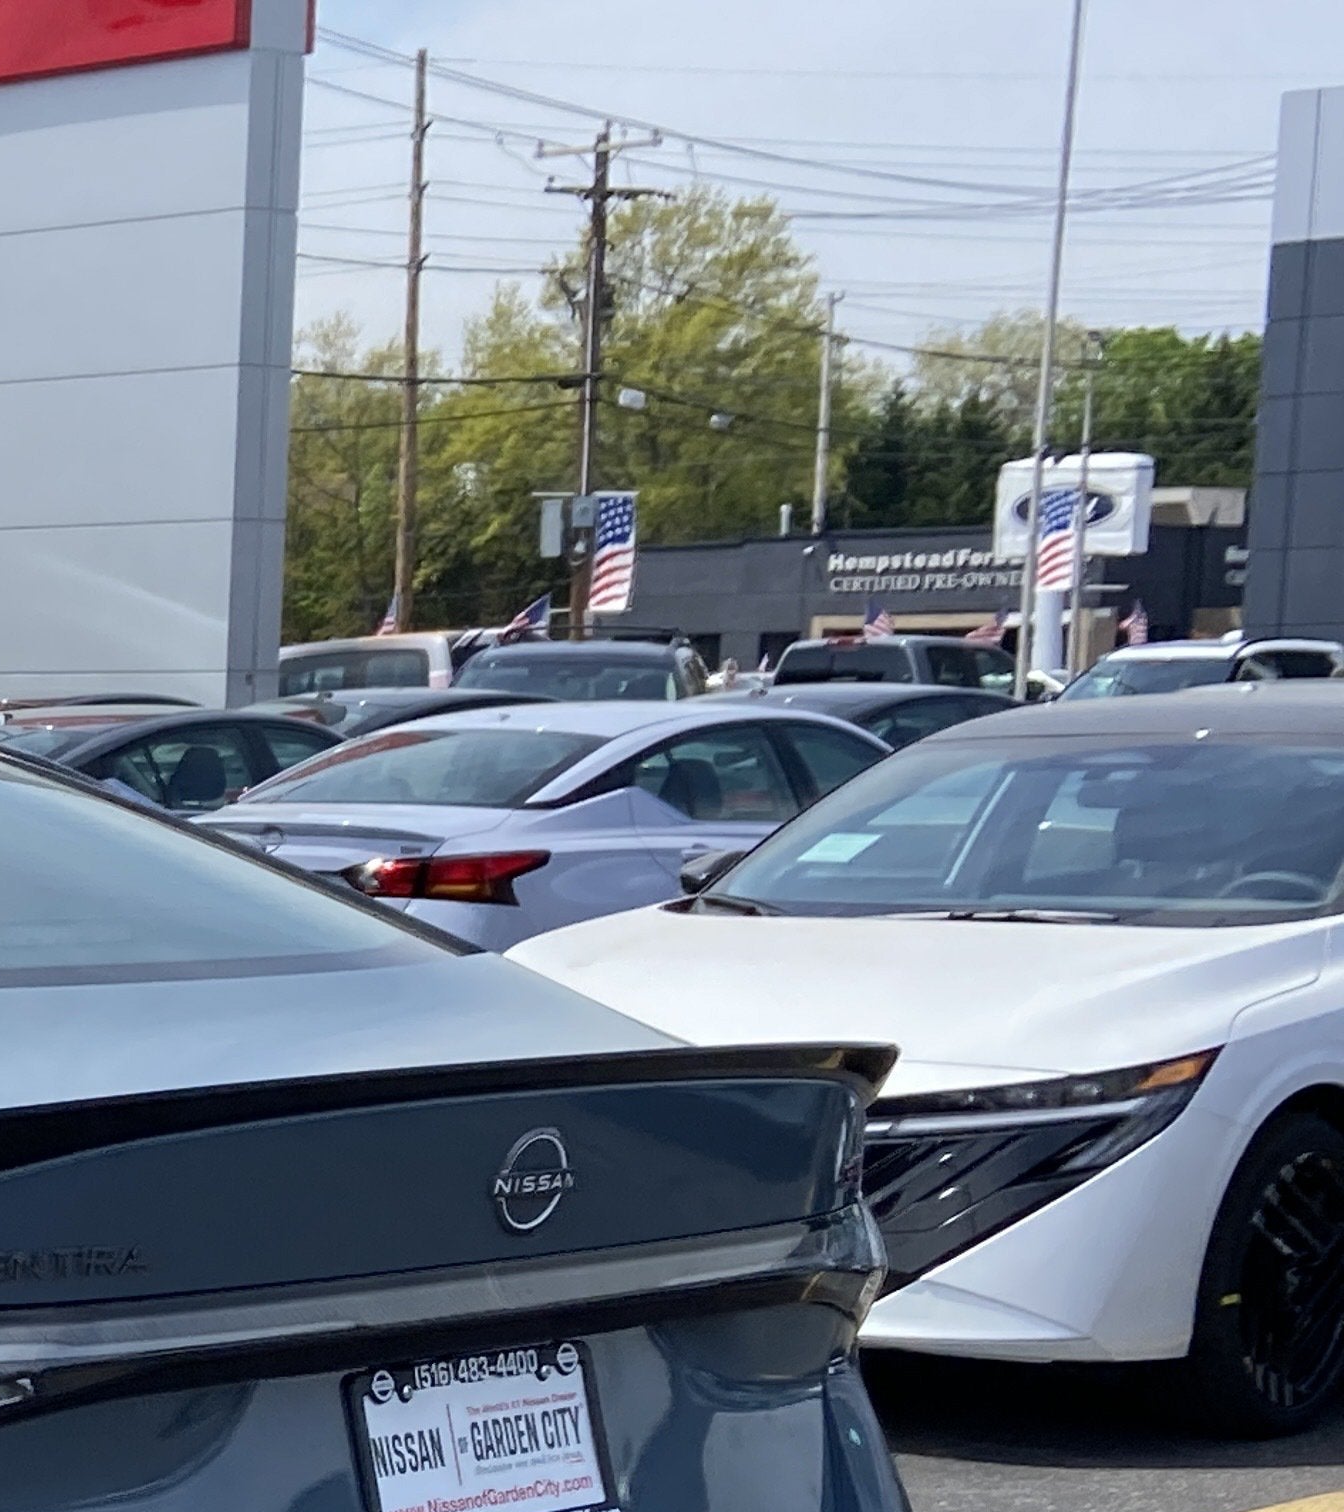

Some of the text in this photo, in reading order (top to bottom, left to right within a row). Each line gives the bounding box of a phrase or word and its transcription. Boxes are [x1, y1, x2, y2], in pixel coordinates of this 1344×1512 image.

[830, 570, 1025, 592] CERTIFIED PRE-OWNE
[494, 1172, 575, 1195] NISSAN
[414, 1350, 539, 1388] (516) 483-4400
[371, 1427, 446, 1479] NISSAN
[470, 1413, 541, 1462] GARDEN
